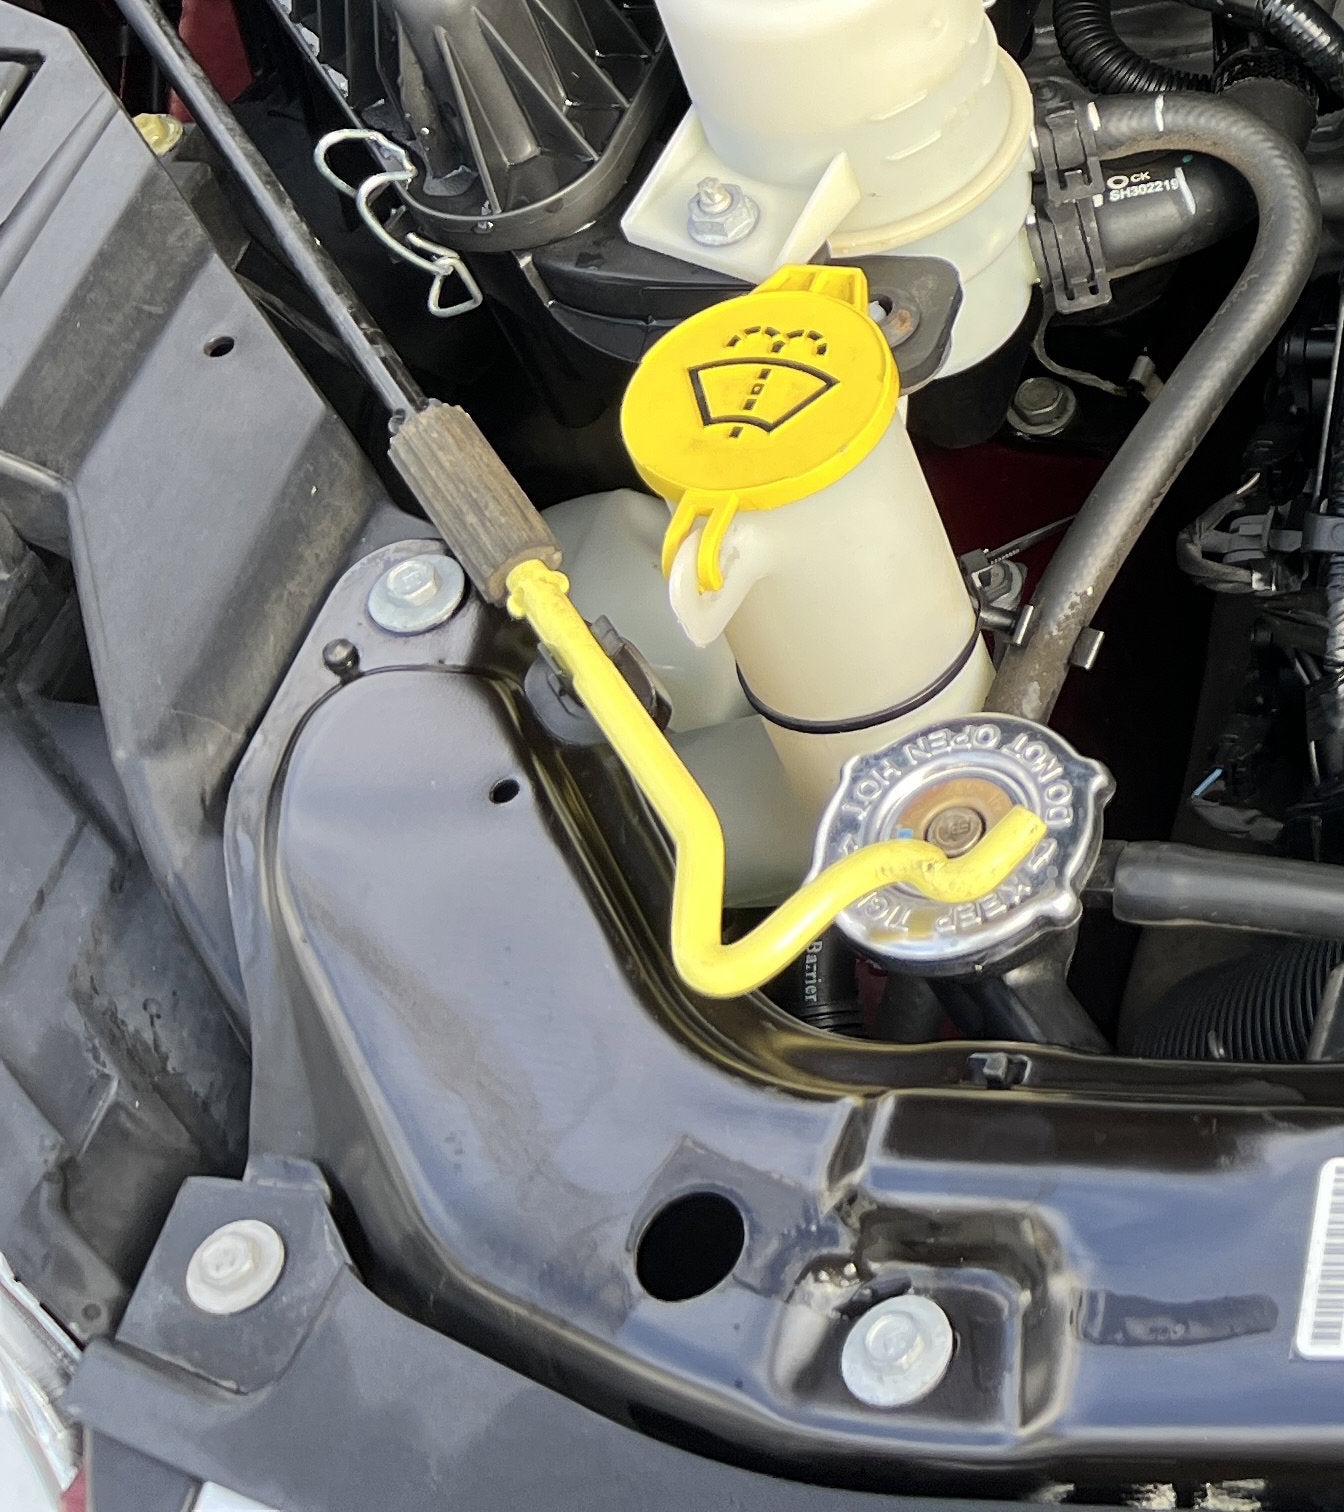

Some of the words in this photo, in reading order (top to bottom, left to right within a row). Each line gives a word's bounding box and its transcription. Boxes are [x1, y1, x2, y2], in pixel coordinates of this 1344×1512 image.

[904, 723, 1001, 764] OPEN
[1001, 731, 1064, 782] NOT
[841, 759, 902, 820] HOT
[1044, 780, 1073, 825] DO
[855, 890, 910, 933] TIG
[935, 884, 1032, 935] KEEP
[804, 941, 822, 1002] Barrier
